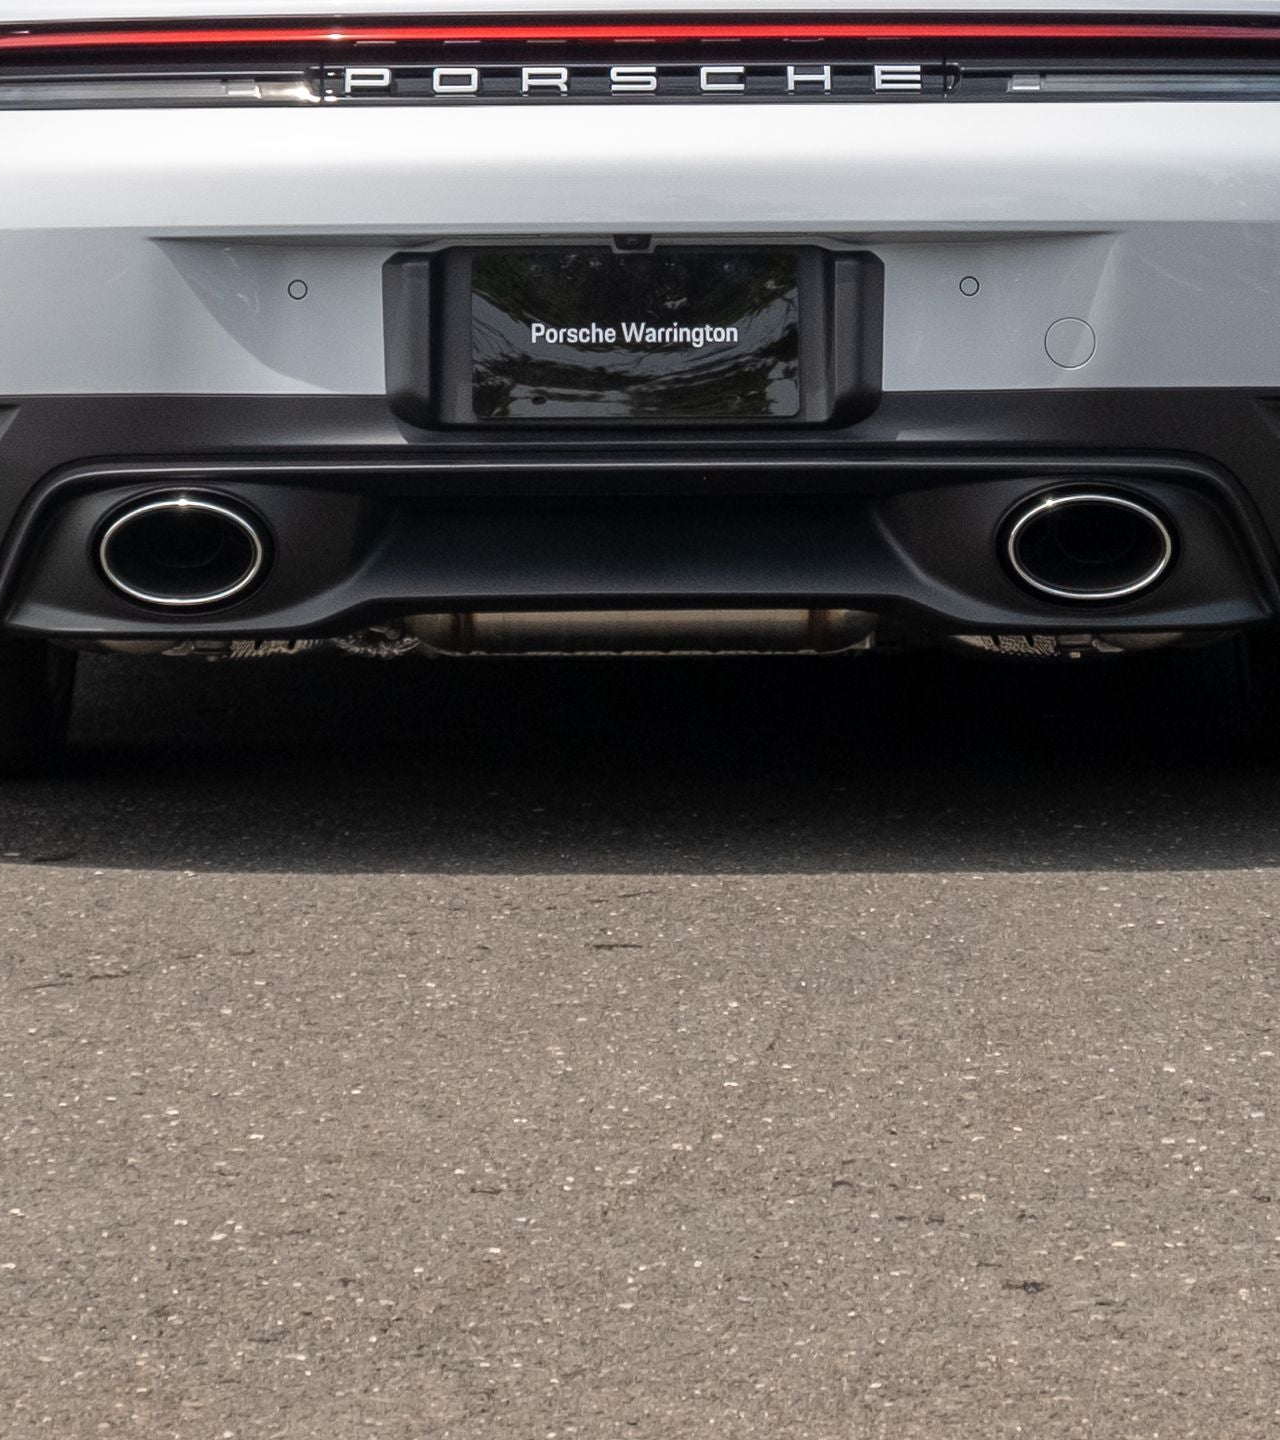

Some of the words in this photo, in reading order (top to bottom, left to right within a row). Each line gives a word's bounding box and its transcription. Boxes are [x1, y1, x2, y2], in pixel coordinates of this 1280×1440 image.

[344, 65, 922, 94] PORSCHE
[531, 322, 616, 344] Porsche
[621, 322, 739, 348] Warrington
